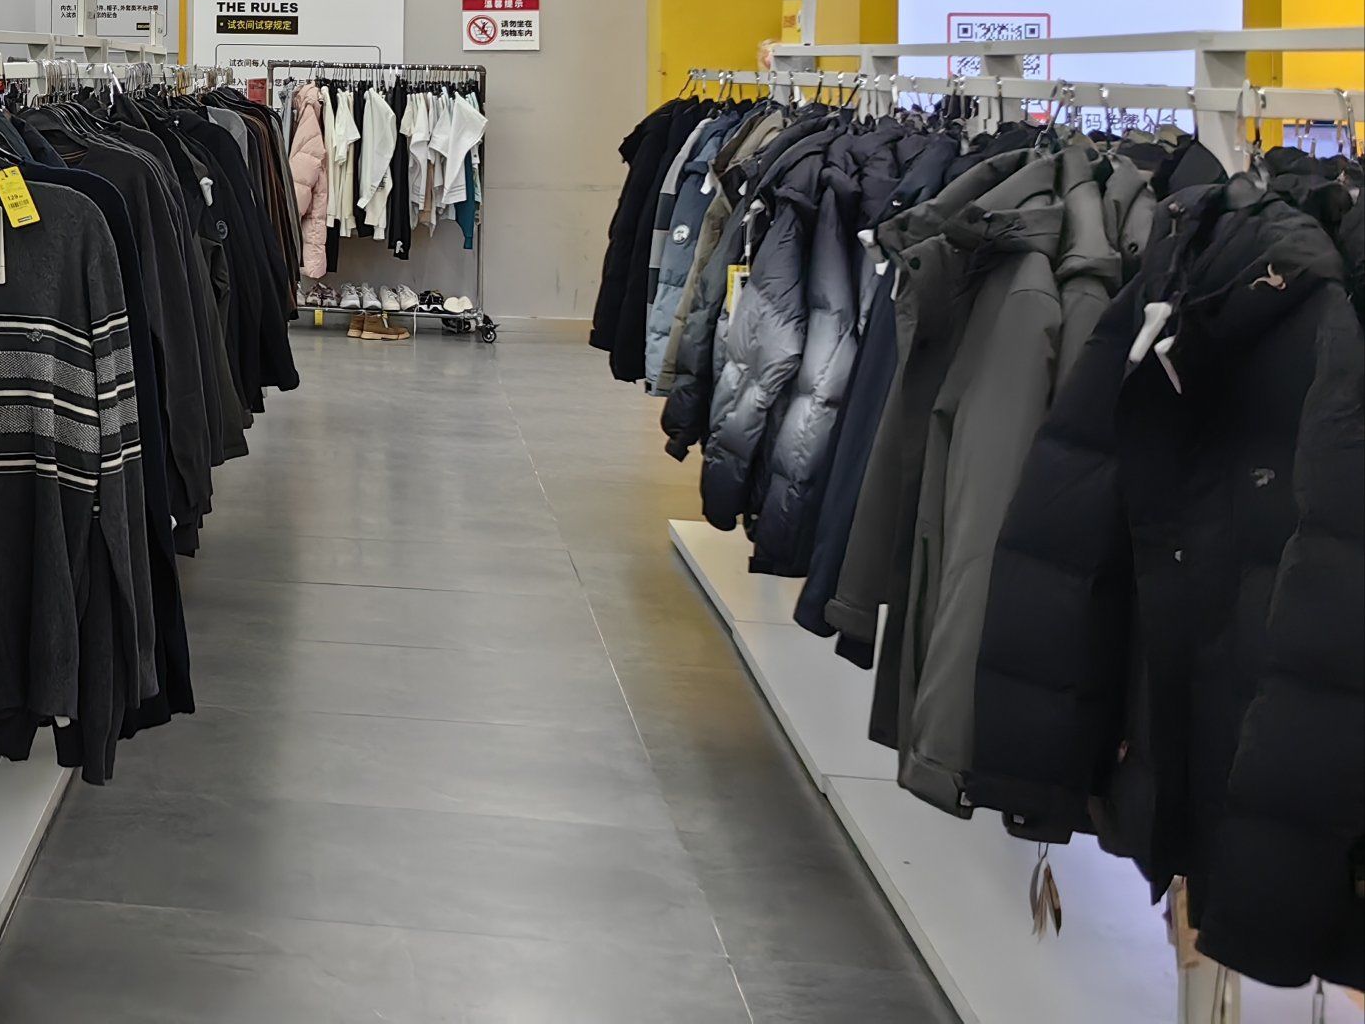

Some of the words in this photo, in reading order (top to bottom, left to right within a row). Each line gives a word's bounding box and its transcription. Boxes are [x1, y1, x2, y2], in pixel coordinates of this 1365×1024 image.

[217, 2, 246, 13] THE
[250, 2, 299, 13] RULES
[484, 0, 524, 9] 温馨提示
[227, 20, 292, 31] 试衣间试穿规定
[501, 20, 533, 28] 请勿坐在
[501, 29, 533, 37] 购物车内
